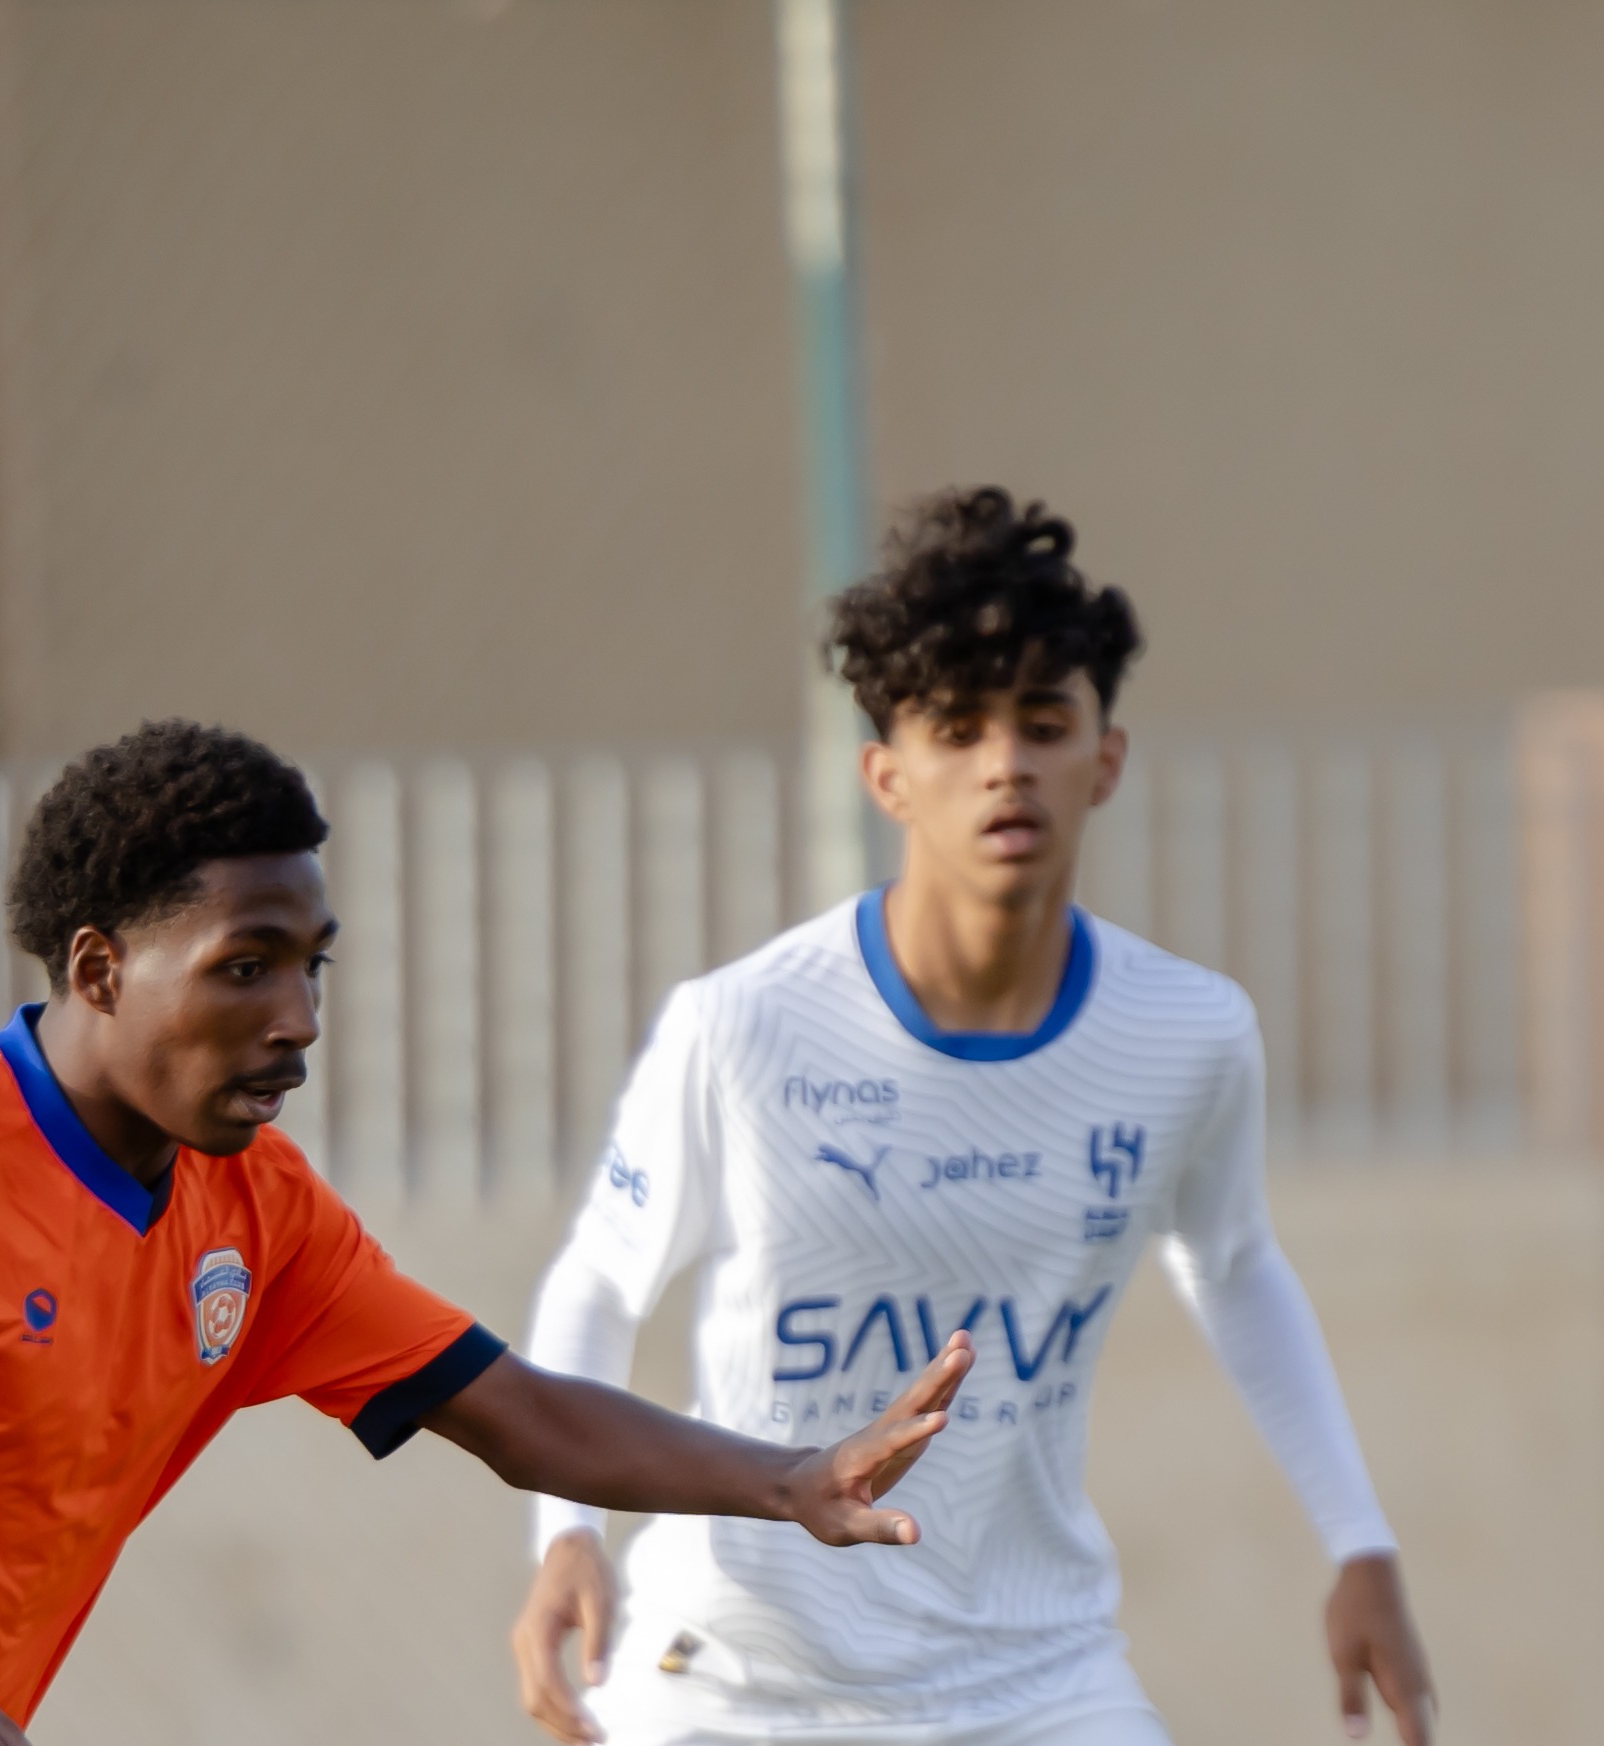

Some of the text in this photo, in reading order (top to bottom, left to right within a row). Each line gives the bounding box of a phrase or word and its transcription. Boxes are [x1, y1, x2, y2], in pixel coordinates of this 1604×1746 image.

[784, 1075, 900, 1114] flynas
[920, 1146, 1043, 1188] jahez
[771, 1389, 892, 1422] GAME
